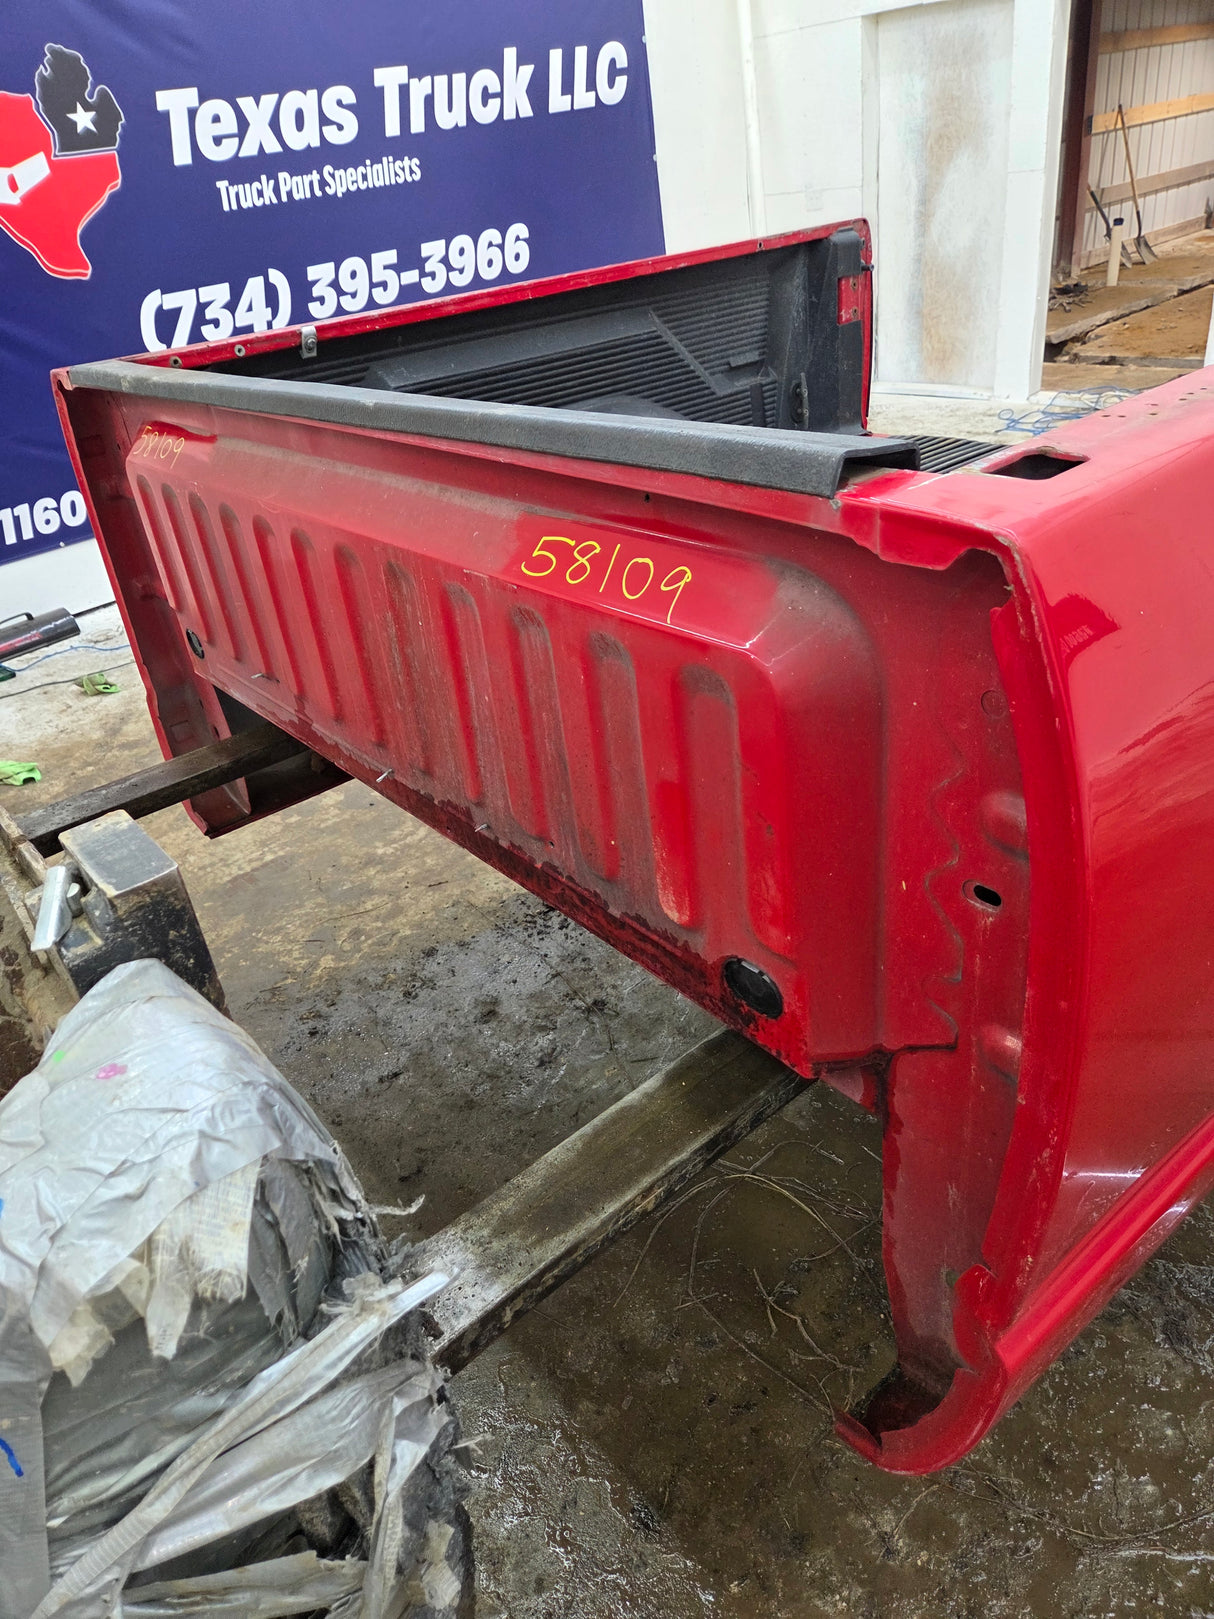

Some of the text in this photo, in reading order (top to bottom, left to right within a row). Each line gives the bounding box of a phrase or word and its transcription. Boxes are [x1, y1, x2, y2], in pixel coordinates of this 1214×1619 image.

[156, 41, 628, 166] Texas Truck LLC
[216, 156, 421, 212] Truck Part Specialists
[140, 223, 530, 352] (734) 395-3966
[133, 425, 185, 469] 58109
[0, 490, 87, 545] 1160
[521, 536, 692, 624] 58109
